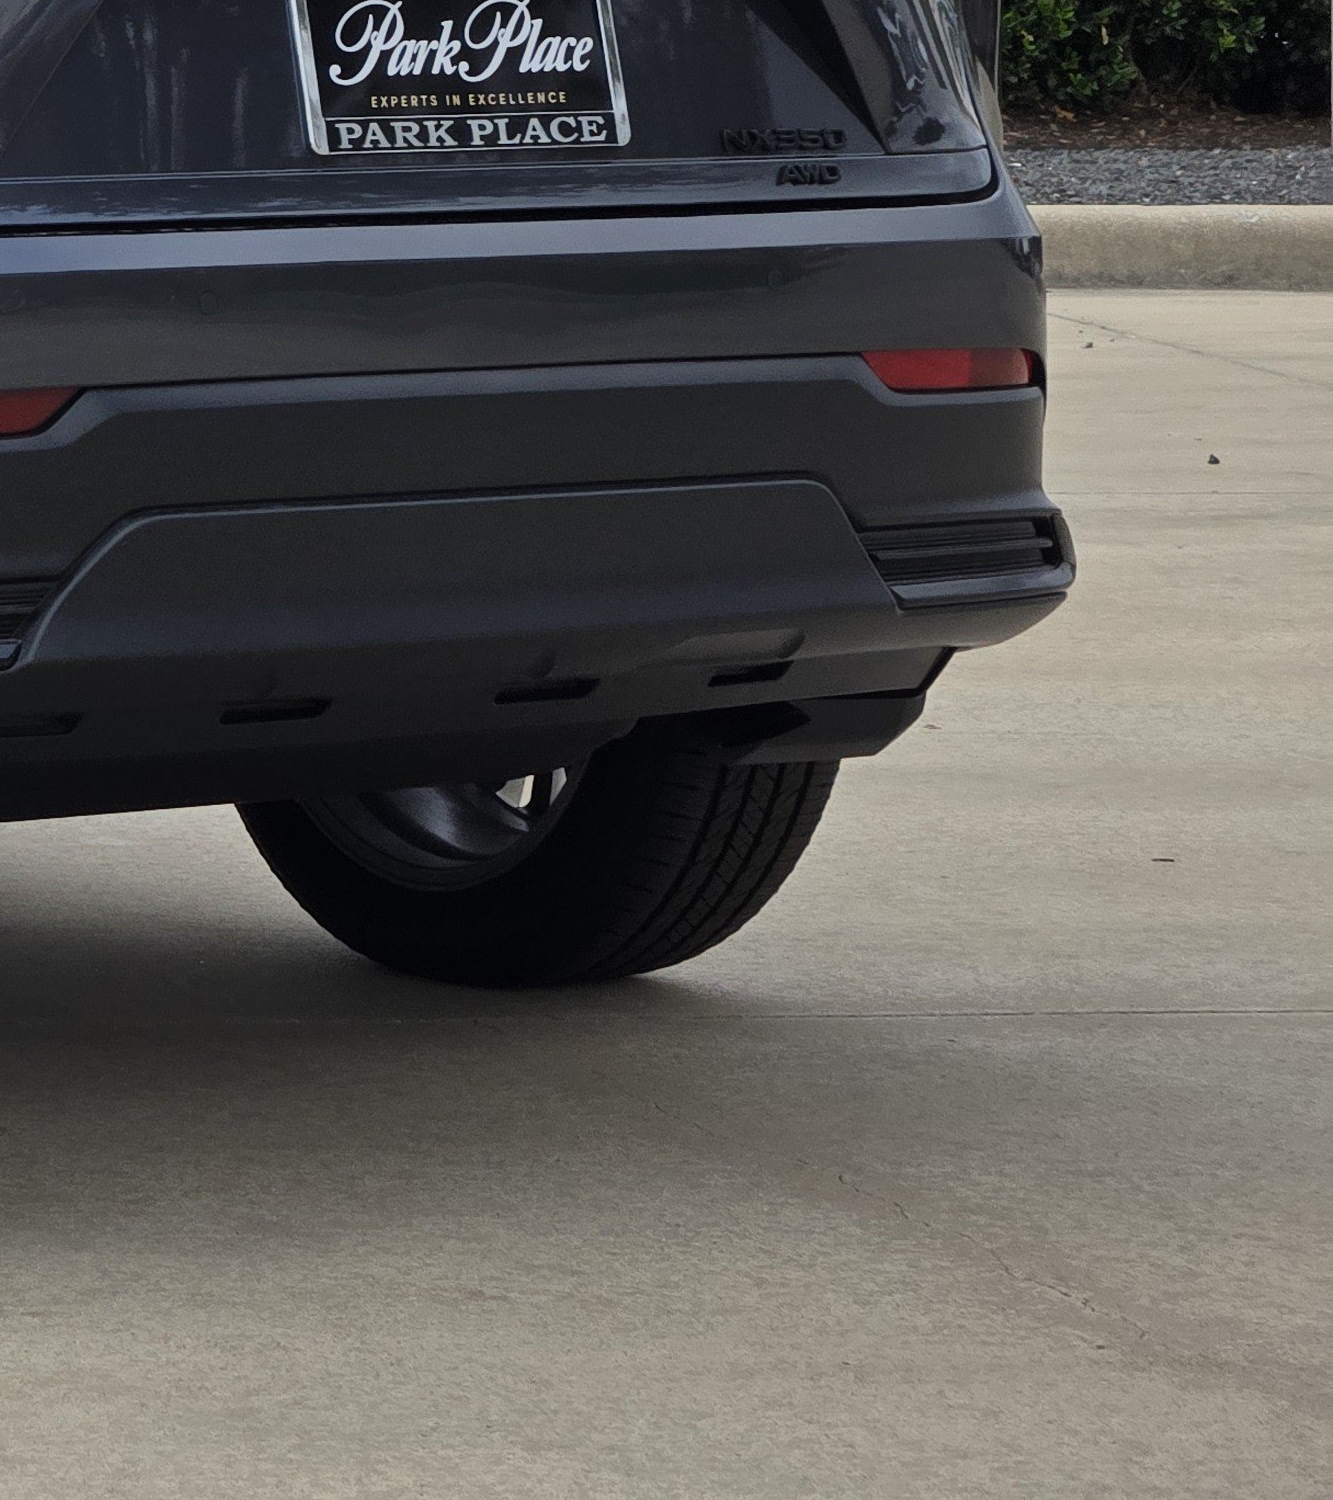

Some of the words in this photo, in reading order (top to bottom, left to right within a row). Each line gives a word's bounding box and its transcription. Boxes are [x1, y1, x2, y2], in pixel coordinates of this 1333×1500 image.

[329, 0, 462, 86] Park
[370, 95, 439, 109] EXPERTS
[446, 94, 461, 106] IN
[468, 91, 568, 106] EXCELLENCE
[334, 120, 459, 149] PARK
[466, 115, 609, 146] PLACE
[775, 163, 842, 187] AWD
